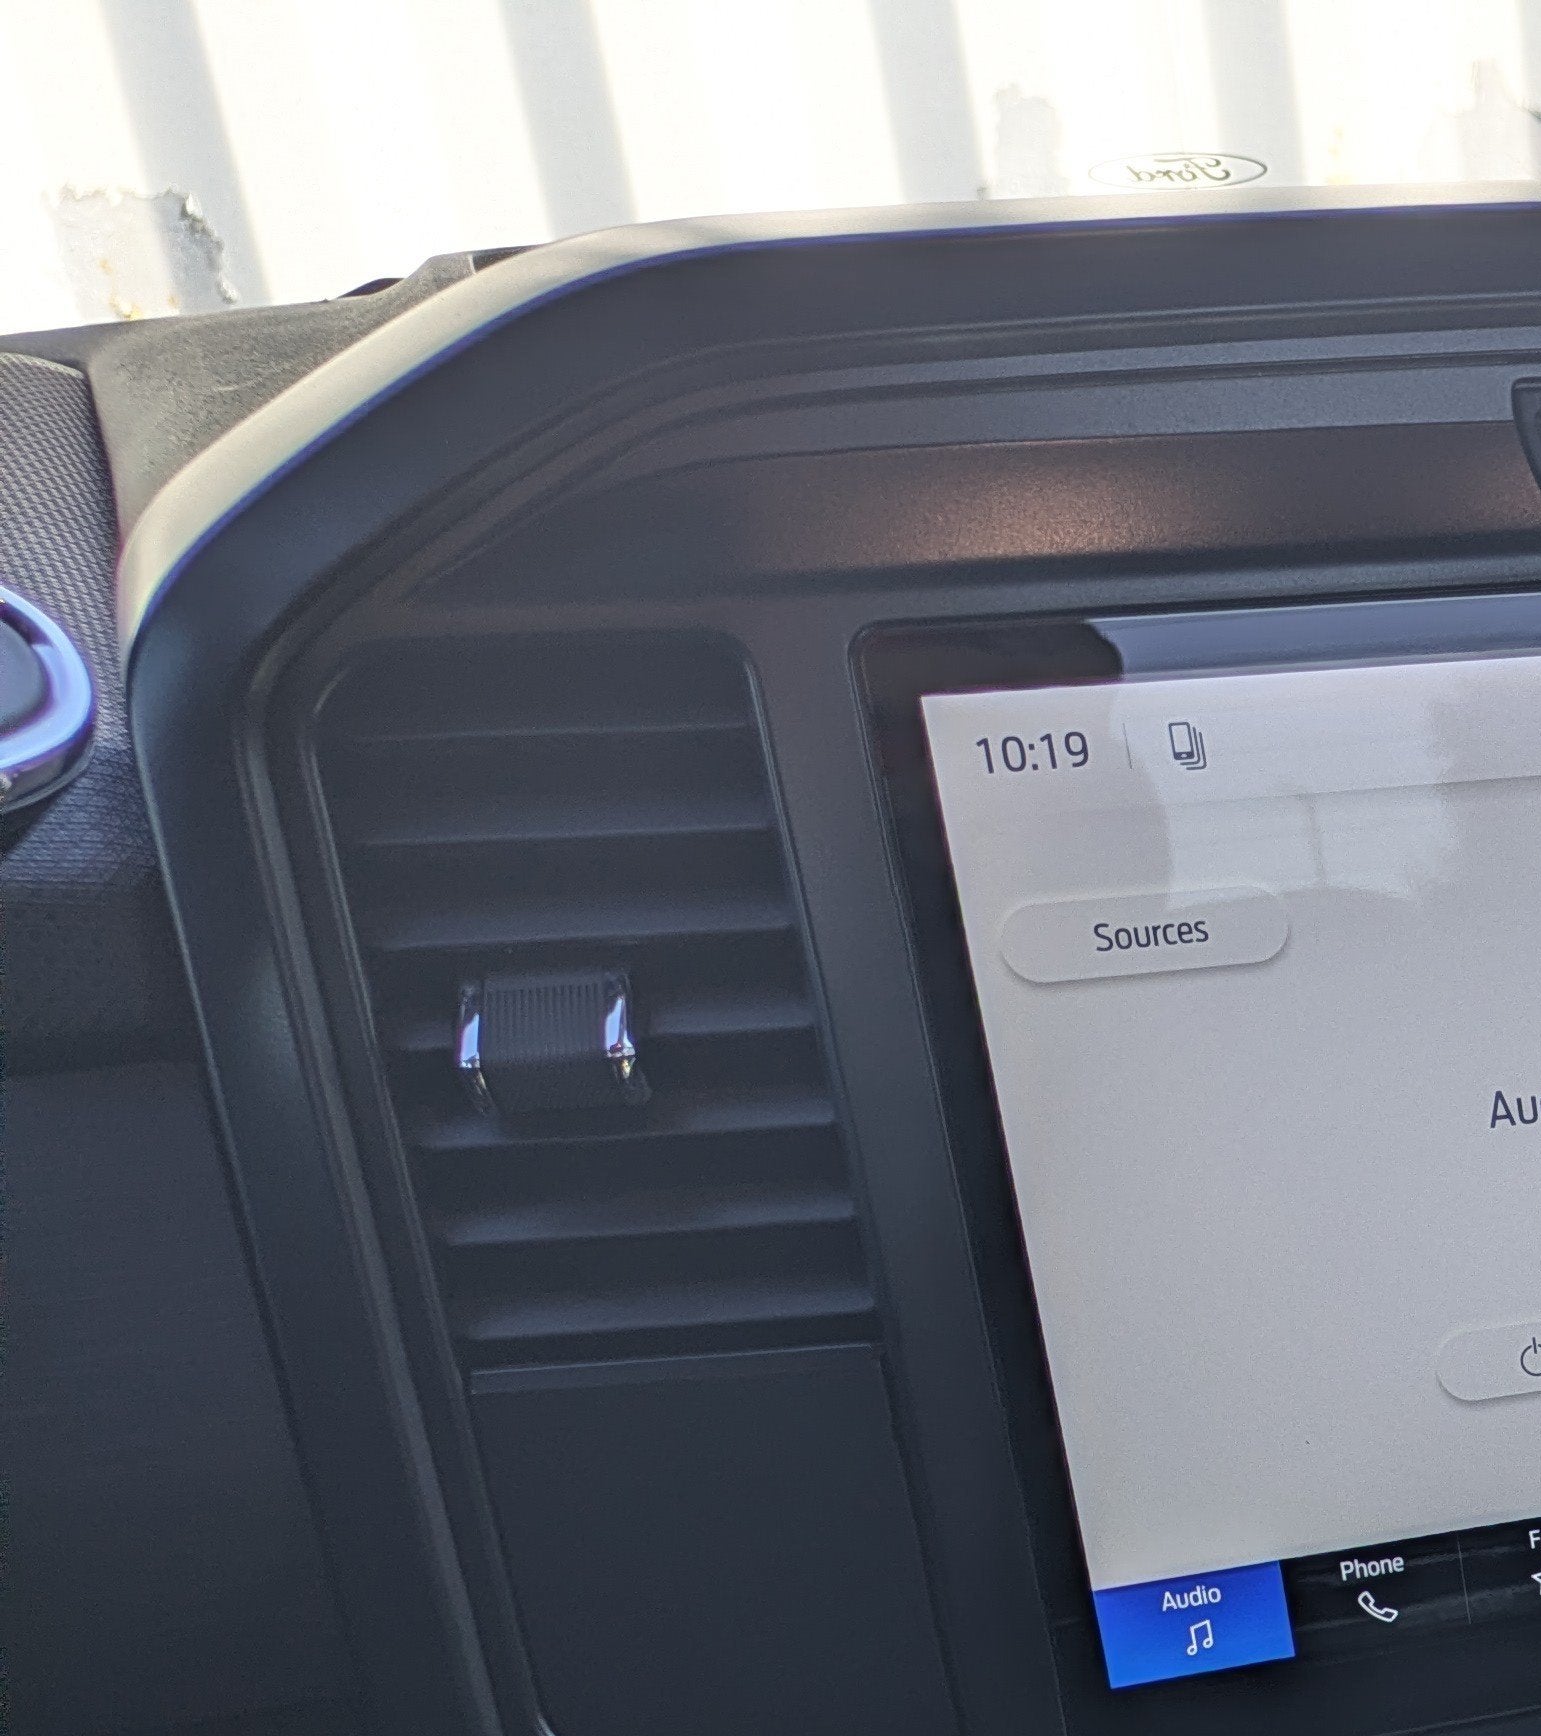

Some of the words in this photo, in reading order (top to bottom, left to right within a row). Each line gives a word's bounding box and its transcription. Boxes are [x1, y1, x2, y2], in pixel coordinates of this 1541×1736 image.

[975, 730, 1091, 774] 10:19
[1093, 916, 1210, 952] Sources
[1340, 1553, 1405, 1581] Phone
[1161, 1583, 1222, 1612] Audio
